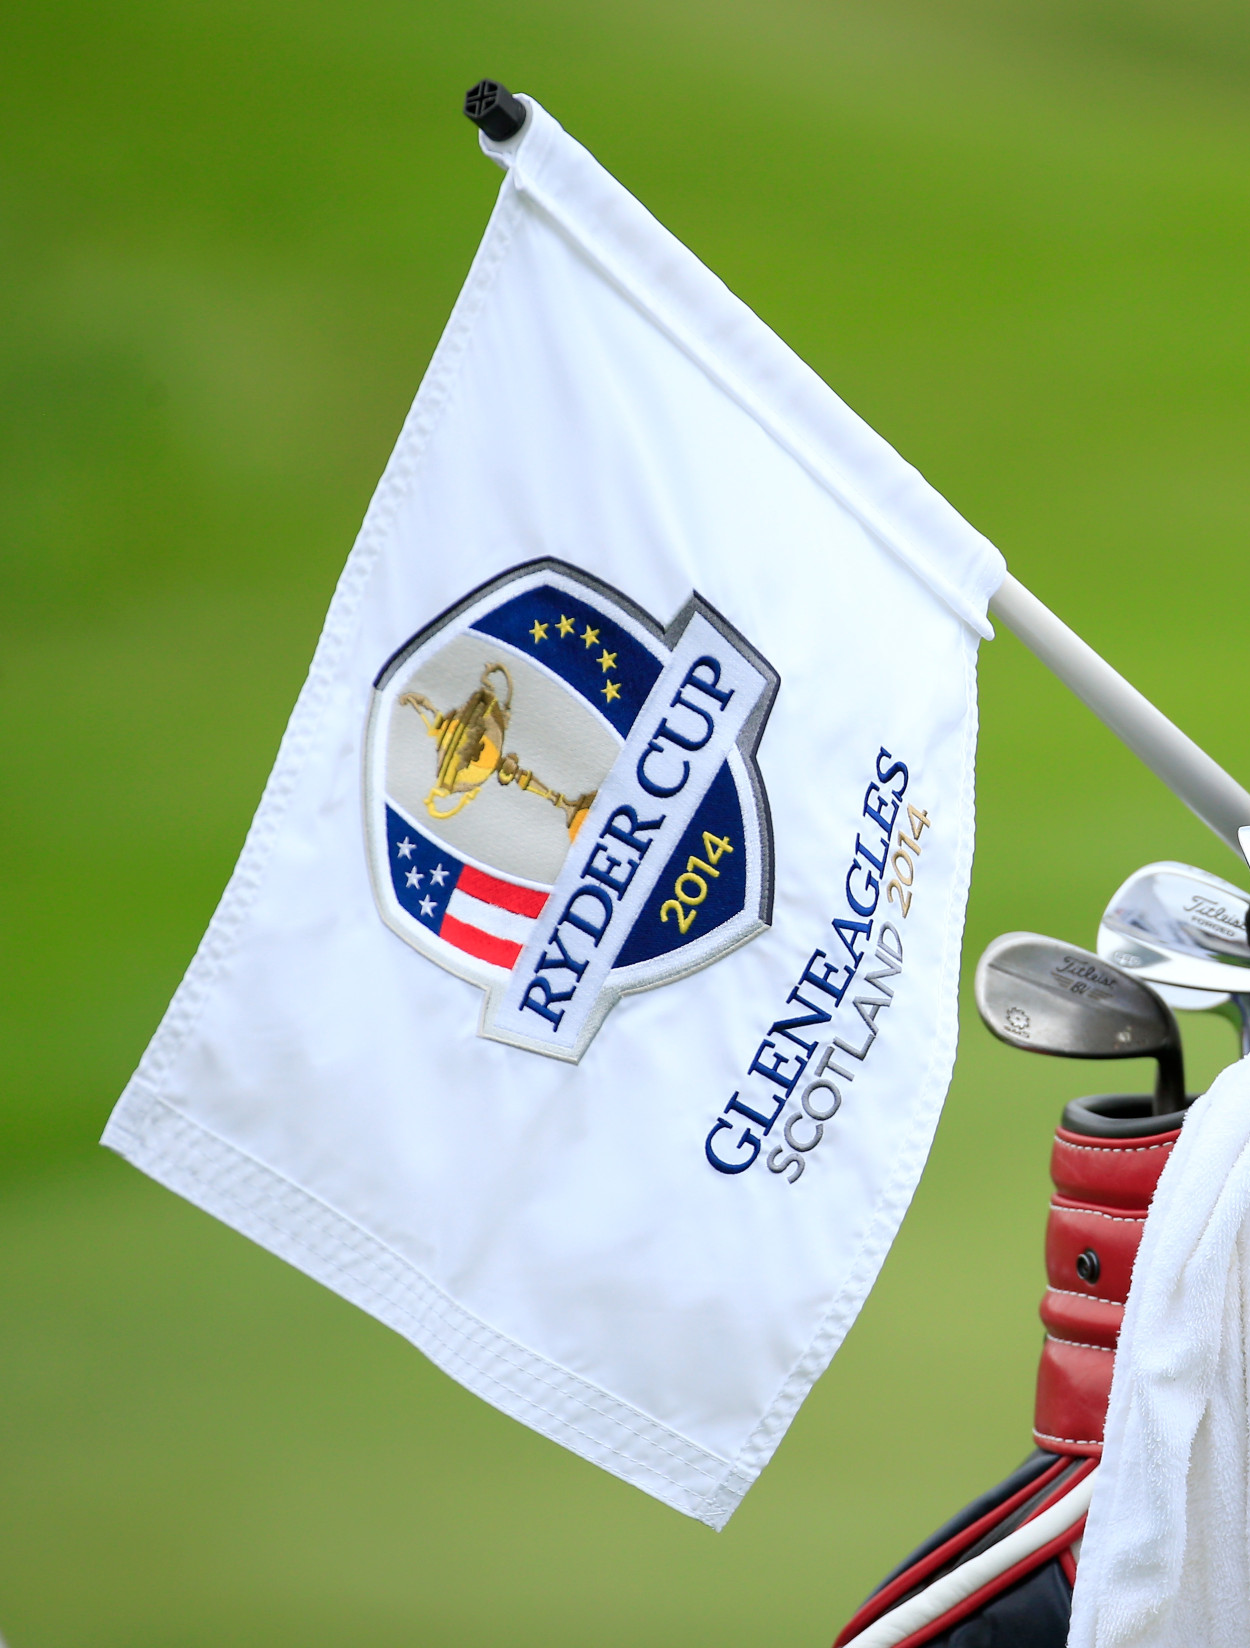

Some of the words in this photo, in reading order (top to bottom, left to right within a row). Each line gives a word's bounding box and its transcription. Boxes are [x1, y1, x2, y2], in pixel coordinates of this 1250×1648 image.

[519, 803, 665, 1031] RYDER
[635, 654, 735, 797] CUP
[660, 829, 733, 934] 2014
[704, 746, 908, 1174] GLENEAGLES
[766, 920, 903, 1184] SCOTLAND
[888, 802, 931, 918] 2014
[1056, 956, 1117, 989] Titleist
